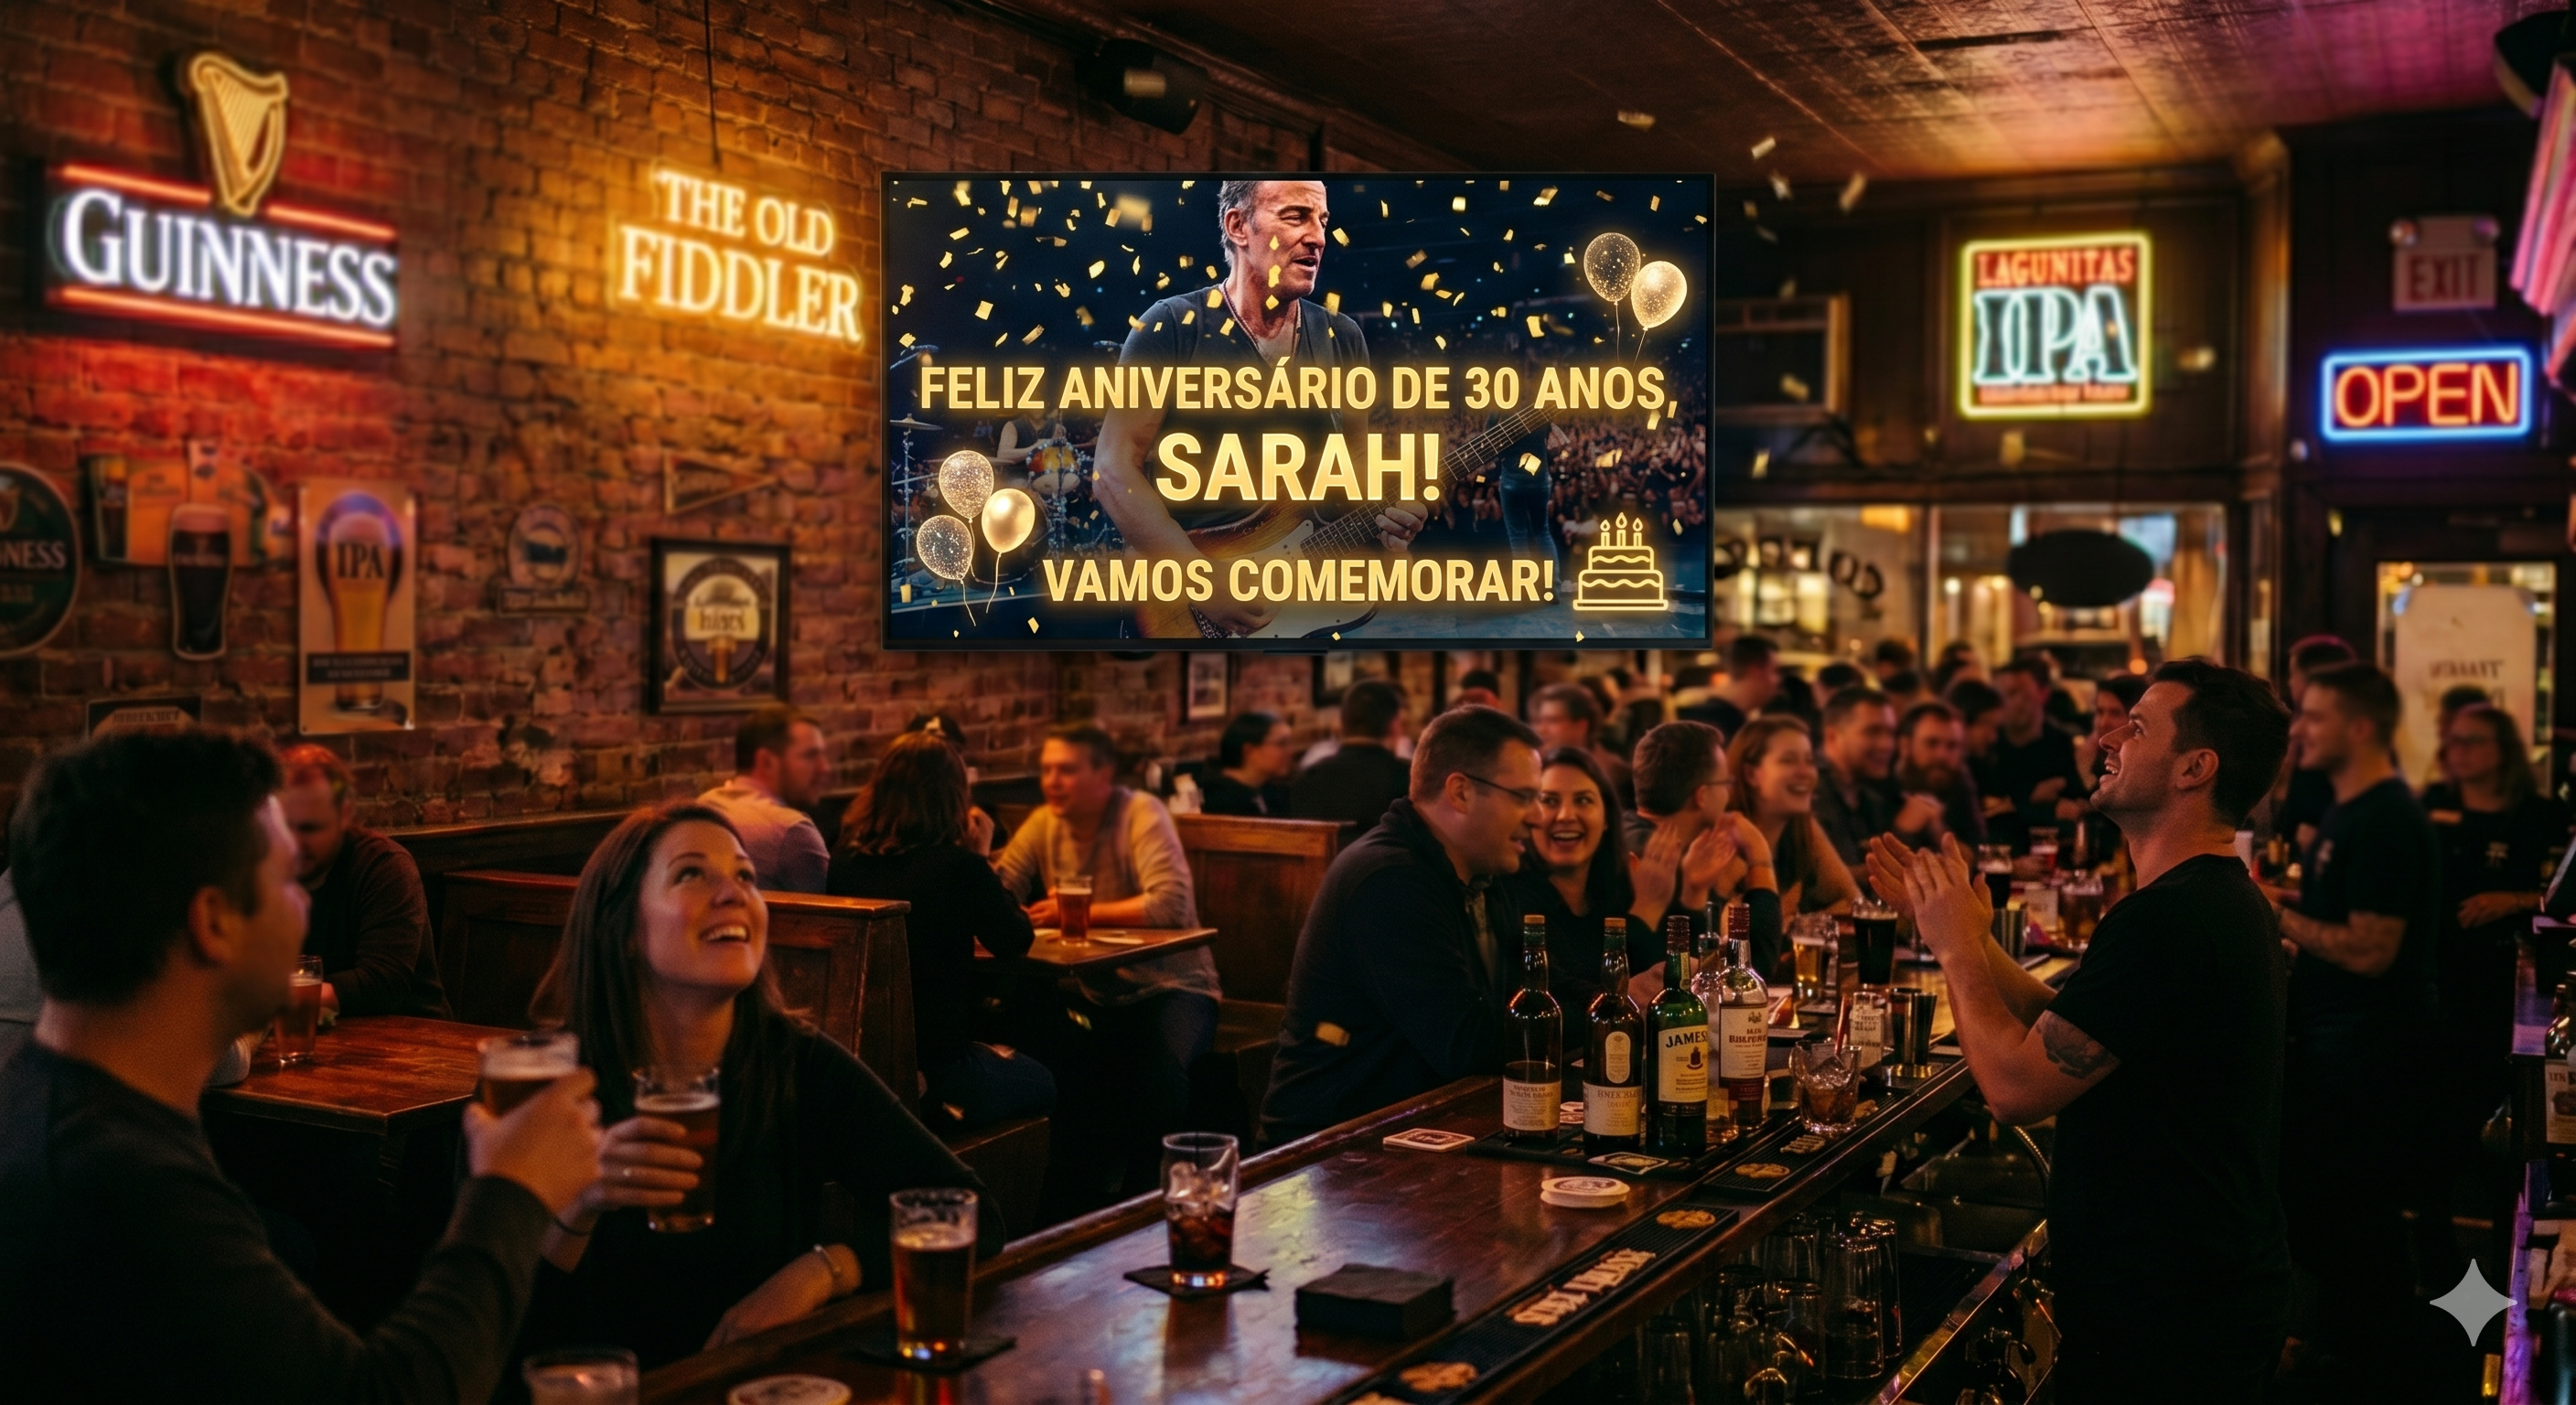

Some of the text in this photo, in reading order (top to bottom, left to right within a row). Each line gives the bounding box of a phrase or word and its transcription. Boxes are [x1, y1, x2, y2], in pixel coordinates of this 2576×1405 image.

[655, 169, 835, 257] THE OLD
[61, 188, 397, 328] GUINNESS
[619, 224, 862, 343] FIDDLER
[1976, 245, 2136, 288] LAGUNITAS
[2409, 253, 2481, 303] EXIT
[1971, 283, 2140, 387] IPA
[920, 356, 1679, 418] FELIZ ANIVERSÁRIO DE 30 ANOS,
[2334, 361, 2518, 428] OPEN
[1154, 432, 1441, 502] SARAH!
[0, 540, 67, 569] NESS
[337, 543, 384, 579] IPA
[1041, 559, 1555, 603] VAMOS COMEMORAR!
